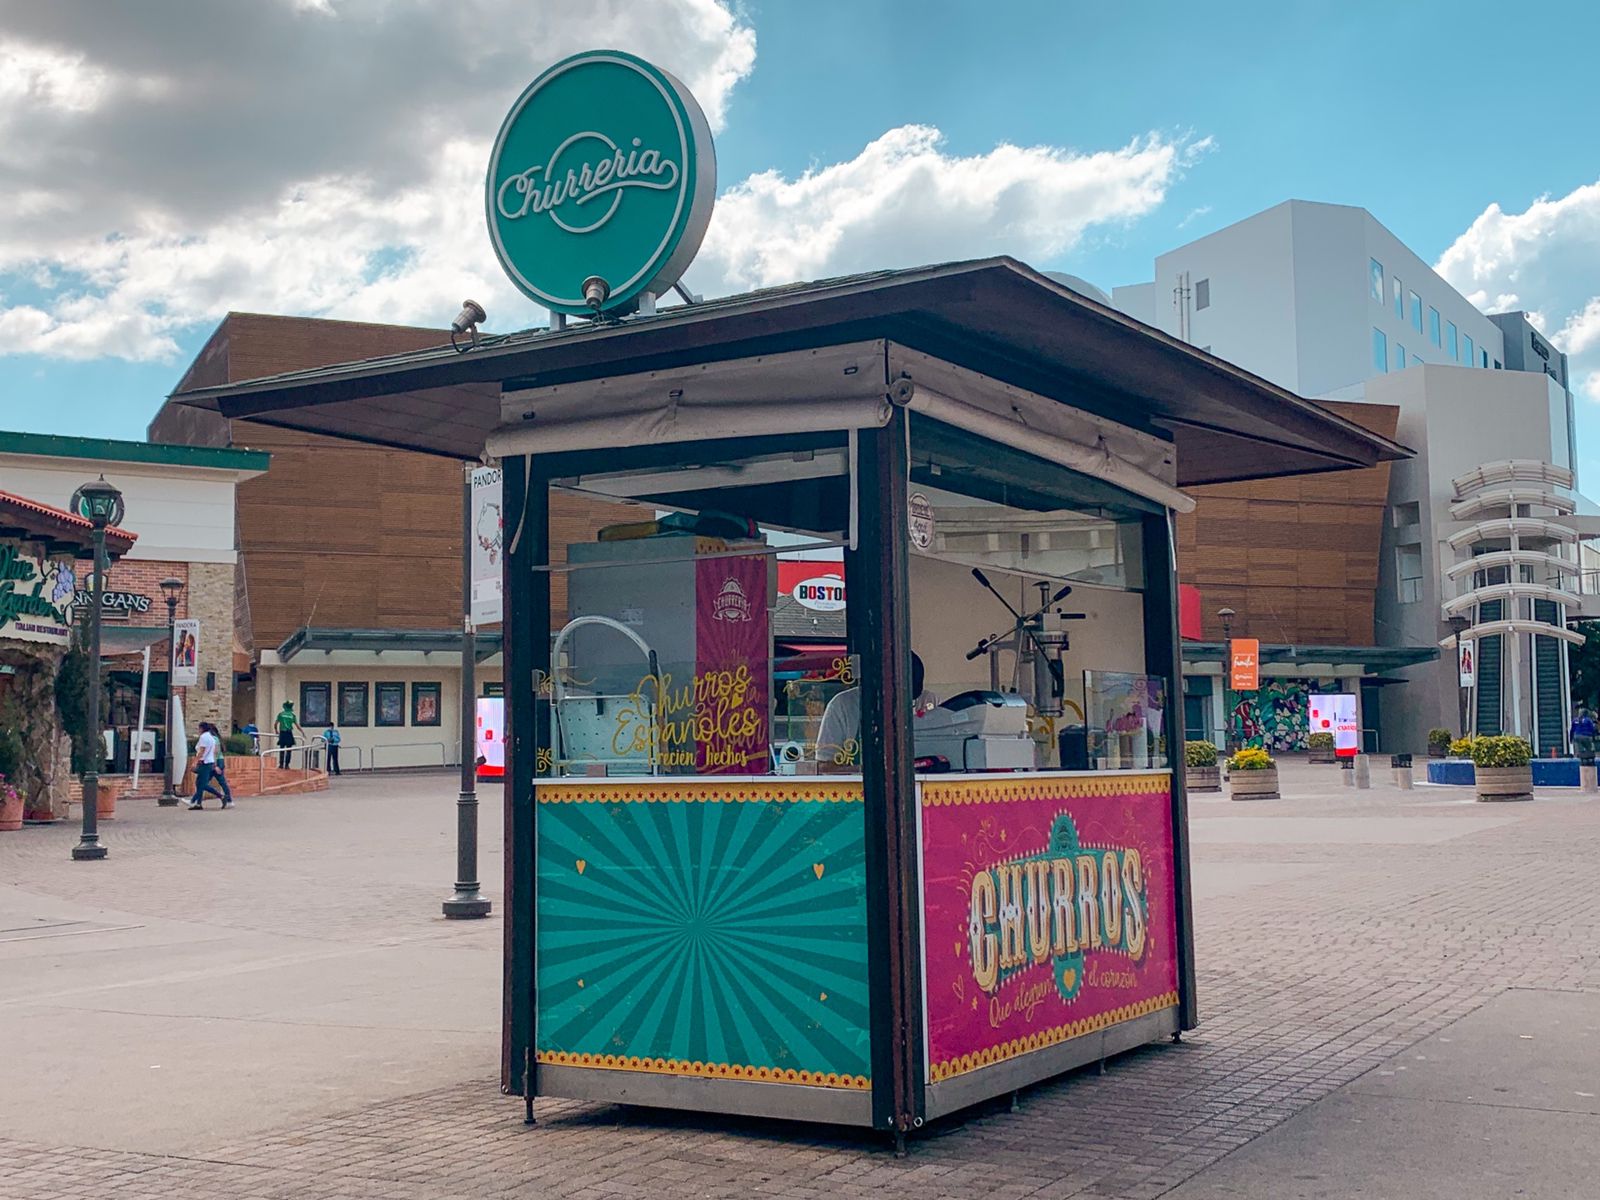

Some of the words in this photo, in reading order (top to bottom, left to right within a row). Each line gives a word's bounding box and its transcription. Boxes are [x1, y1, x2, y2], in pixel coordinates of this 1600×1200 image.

[629, 665, 753, 720] Churros
[612, 697, 761, 767] Españoles
[705, 744, 748, 767] hechos
[970, 848, 1145, 993] CHURROS
[990, 996, 1011, 1028] Que
[1088, 960, 1098, 987] el
